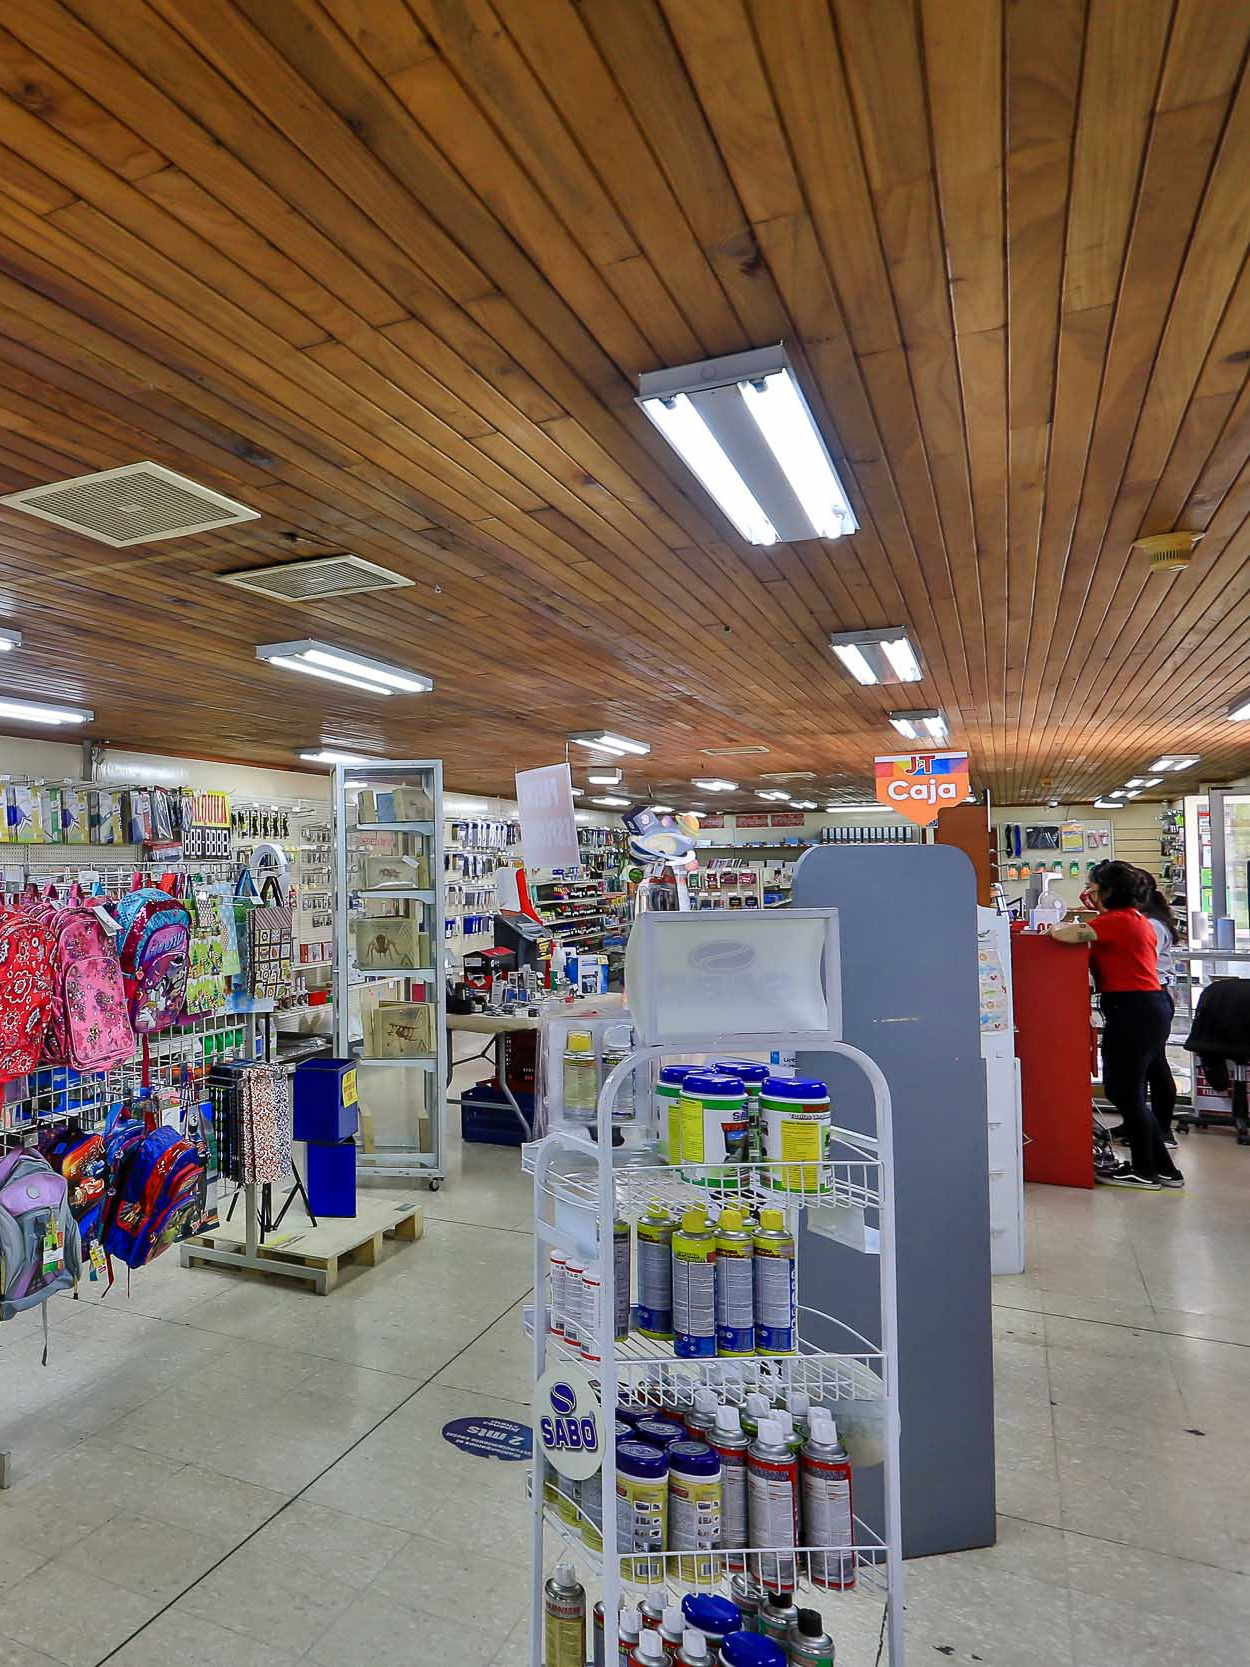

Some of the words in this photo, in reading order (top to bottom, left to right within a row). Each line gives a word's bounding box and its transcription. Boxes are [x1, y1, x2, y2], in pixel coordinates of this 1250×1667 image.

[888, 779, 958, 805] Caja
[508, 1435, 525, 1446] 2
[541, 1416, 598, 1452] SABO
